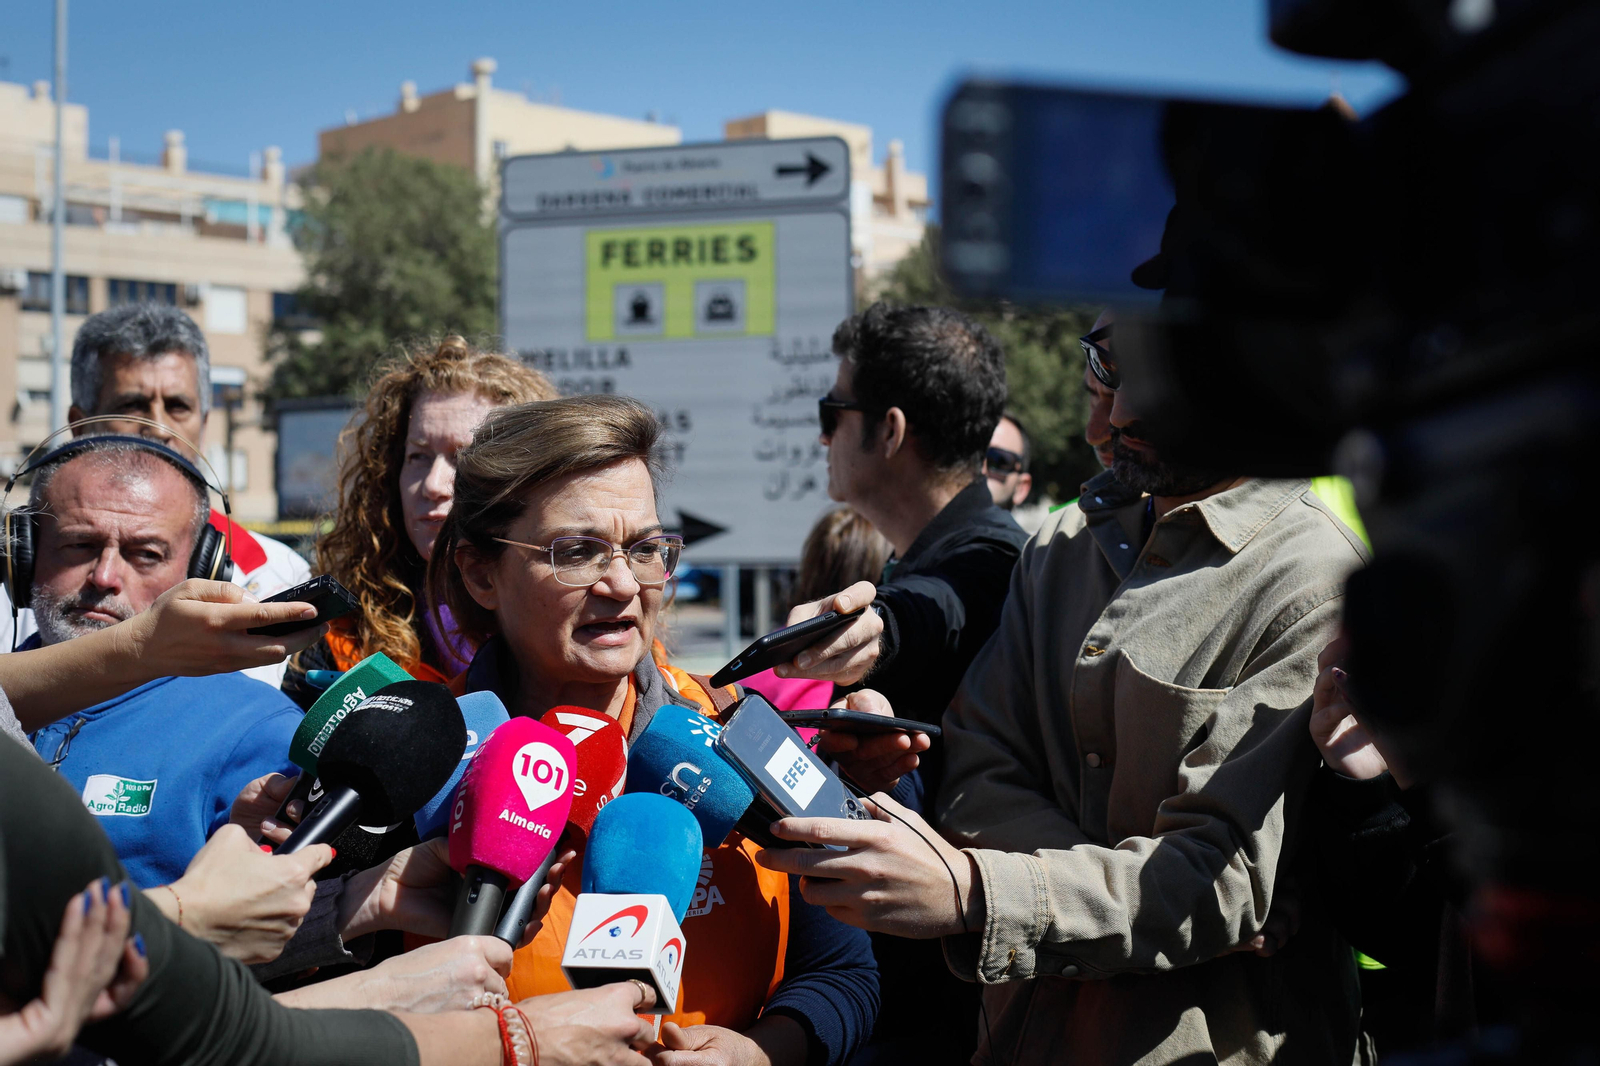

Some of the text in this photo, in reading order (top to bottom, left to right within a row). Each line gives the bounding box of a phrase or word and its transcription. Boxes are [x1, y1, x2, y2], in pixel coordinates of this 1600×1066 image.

[601, 234, 759, 269] FERRIES
[520, 754, 564, 791] 101
[87, 799, 148, 813] Agro Radio
[498, 809, 552, 839] Almería
[691, 885, 726, 909] PA
[572, 948, 644, 960] ATLAS
[656, 960, 676, 1001] ATLAS
